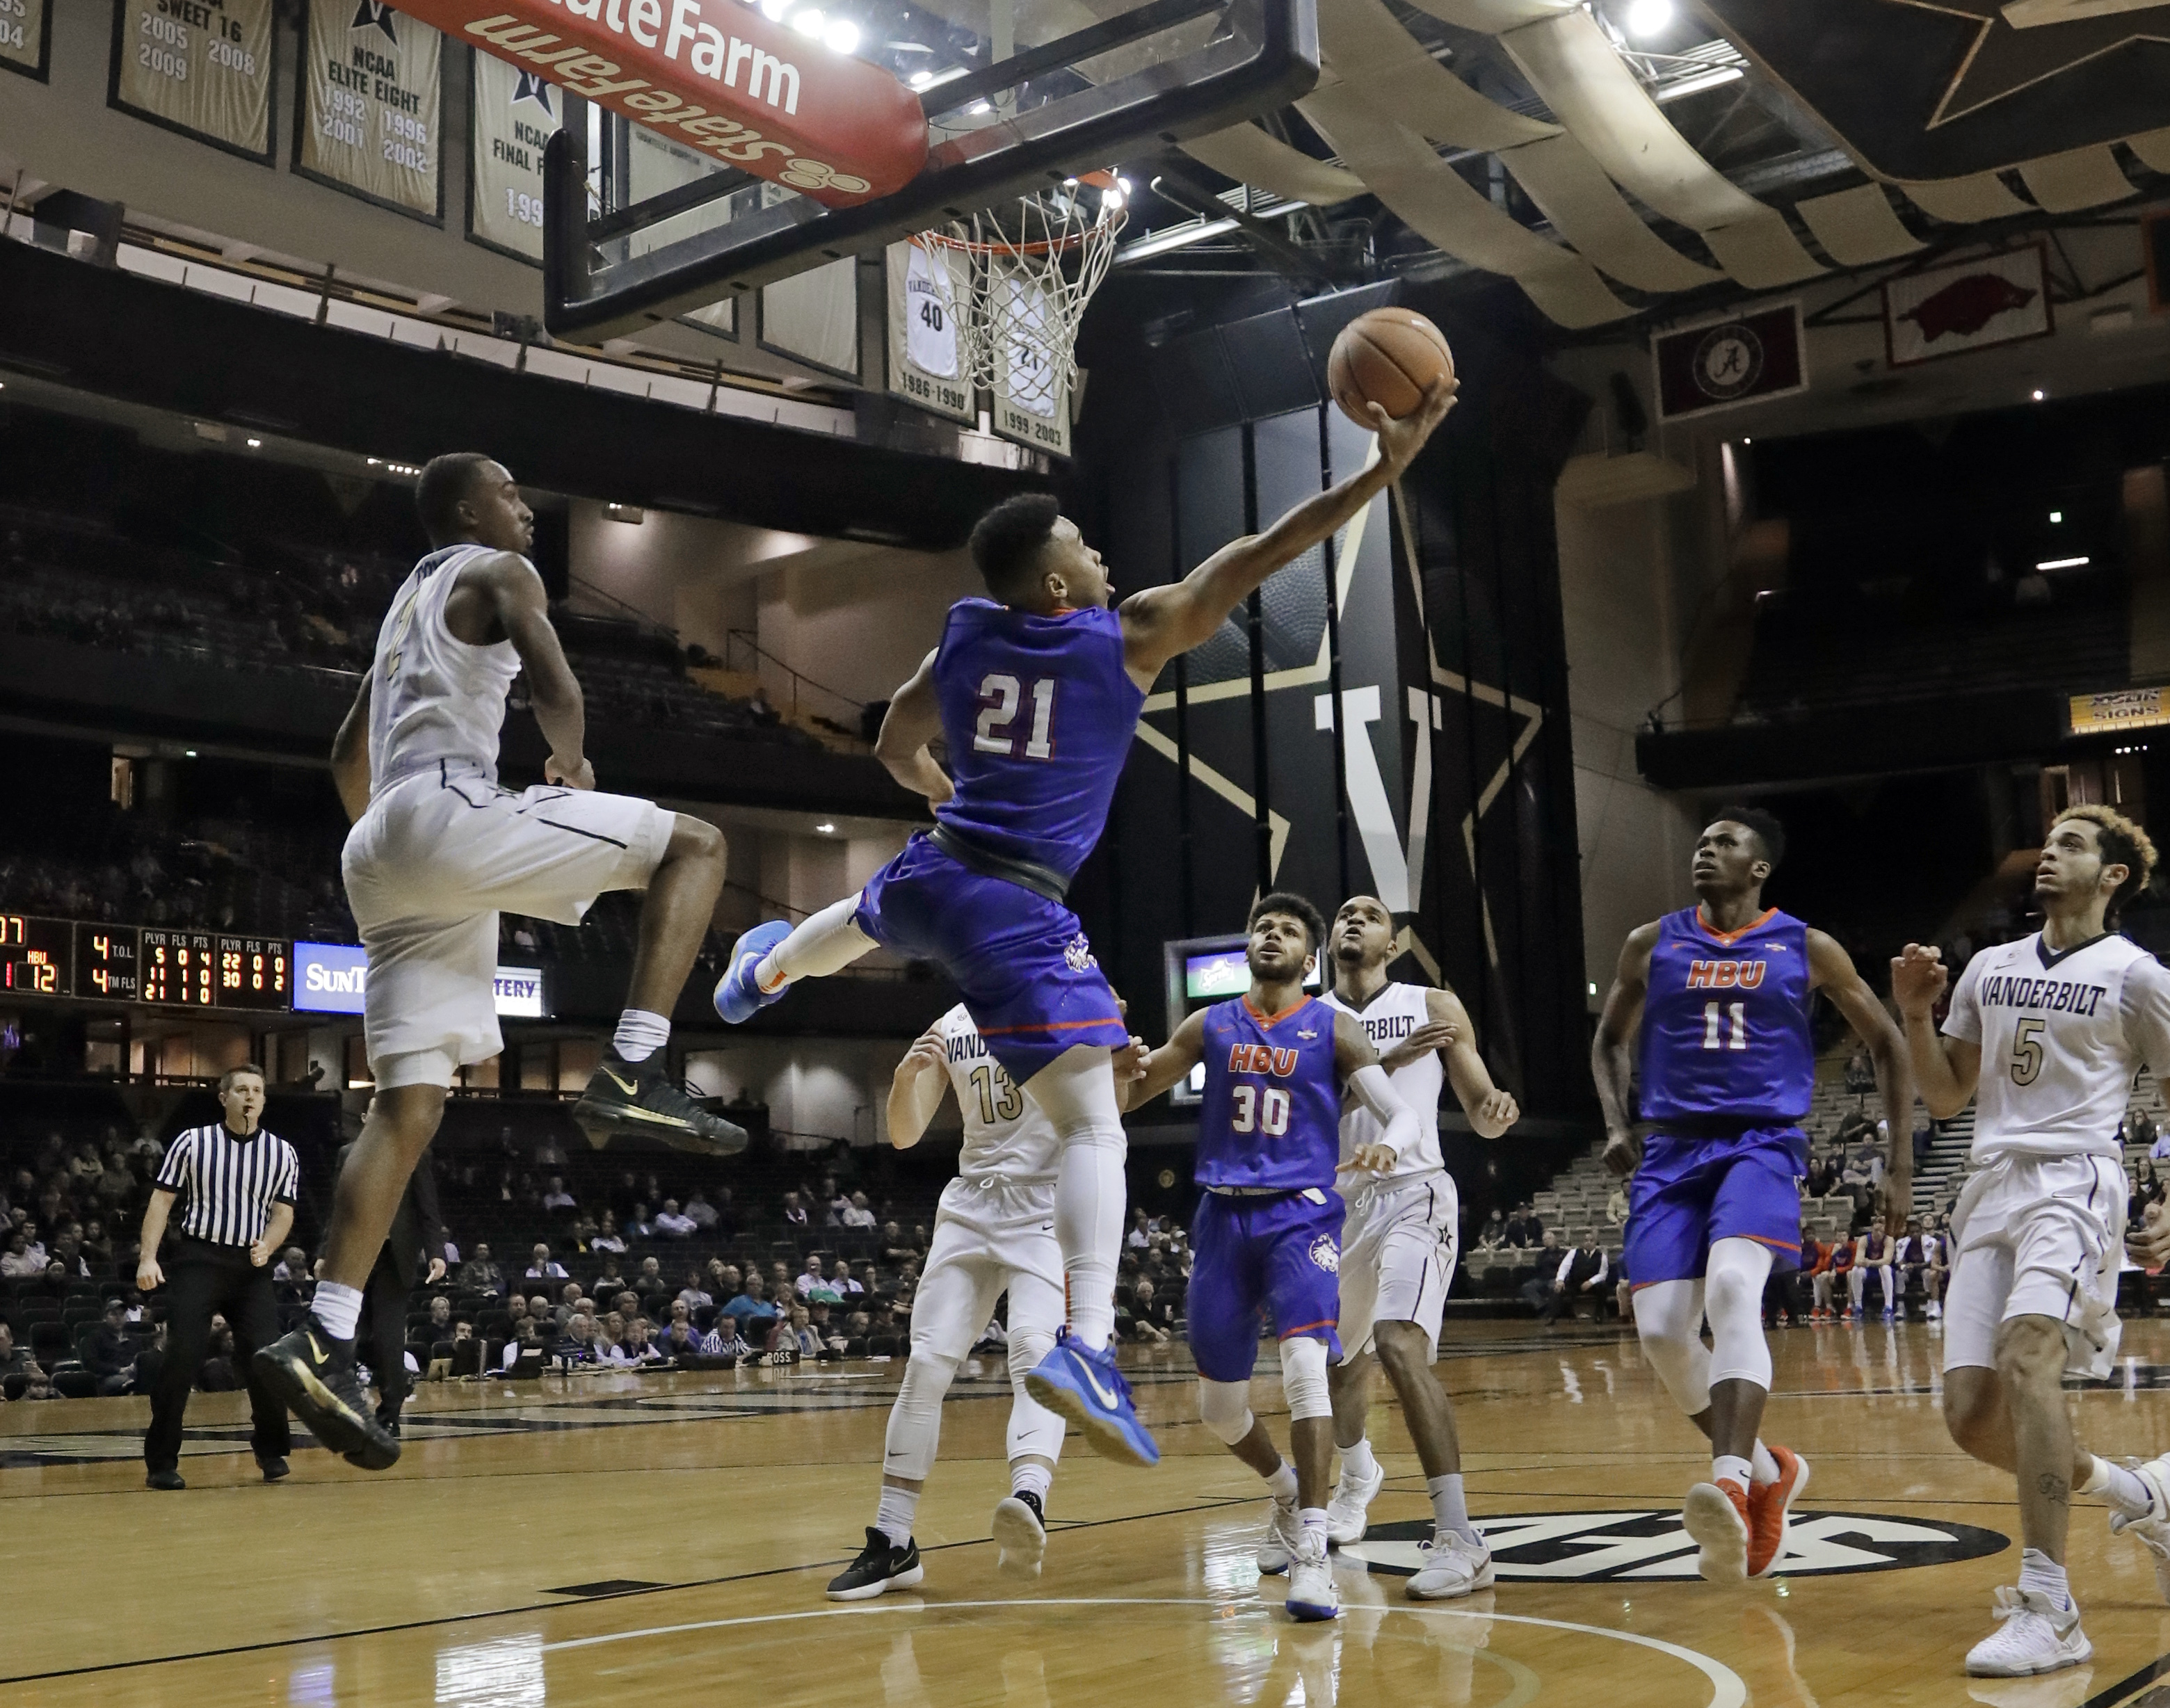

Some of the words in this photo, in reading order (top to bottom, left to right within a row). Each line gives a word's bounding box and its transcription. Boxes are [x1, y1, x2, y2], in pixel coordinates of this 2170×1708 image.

[140, 11, 188, 49] 2005
[220, 15, 242, 42] 16
[139, 42, 187, 81] 2009
[209, 38, 255, 76] 2008
[353, 46, 395, 81] NCAA
[324, 85, 365, 121] 1992
[328, 61, 369, 94] ELITE
[375, 79, 421, 115] EIGHT
[322, 114, 364, 150] 2001
[384, 110, 427, 145] 1996
[383, 139, 427, 174] 2002
[493, 138, 531, 171] FINAL
[921, 300, 943, 332] 40
[903, 373, 965, 410] 1986-1990
[973, 673, 1056, 760] 21
[93, 935, 108, 960] 4
[145, 932, 166, 945] PLYR
[172, 934, 186, 946] FLS
[193, 936, 208, 949] PTS
[155, 946, 165, 964] 5
[177, 949, 188, 966] 0
[200, 952, 211, 966] 4
[221, 939, 241, 951] PLYR
[246, 941, 260, 953] FLS
[268, 942, 282, 955] PTS
[28, 950, 47, 965] HBU
[222, 952, 241, 969] 22
[252, 955, 264, 972] 0
[274, 957, 285, 973] 0
[34, 965, 56, 992] 12
[93, 969, 108, 993] 4
[108, 976, 119, 988] TM
[121, 977, 136, 989] FLS
[150, 966, 166, 981] 11
[182, 969, 188, 983] 1
[200, 969, 211, 985] 0
[223, 971, 241, 988] 30
[252, 973, 263, 990] 0
[274, 975, 284, 991] 2
[1686, 960, 1766, 990] HBU
[145, 983, 166, 1000] 21
[182, 987, 188, 1001] 1
[200, 988, 210, 1004] 0
[1983, 976, 2107, 1017] VANDERBILT
[1360, 1016, 1415, 1040] RBILT
[1703, 1001, 1748, 1050] 11
[1228, 1044, 1299, 1077] HBU
[2011, 1017, 2046, 1086] 5
[970, 1063, 1023, 1124] 13
[1232, 1085, 1291, 1136] 30
